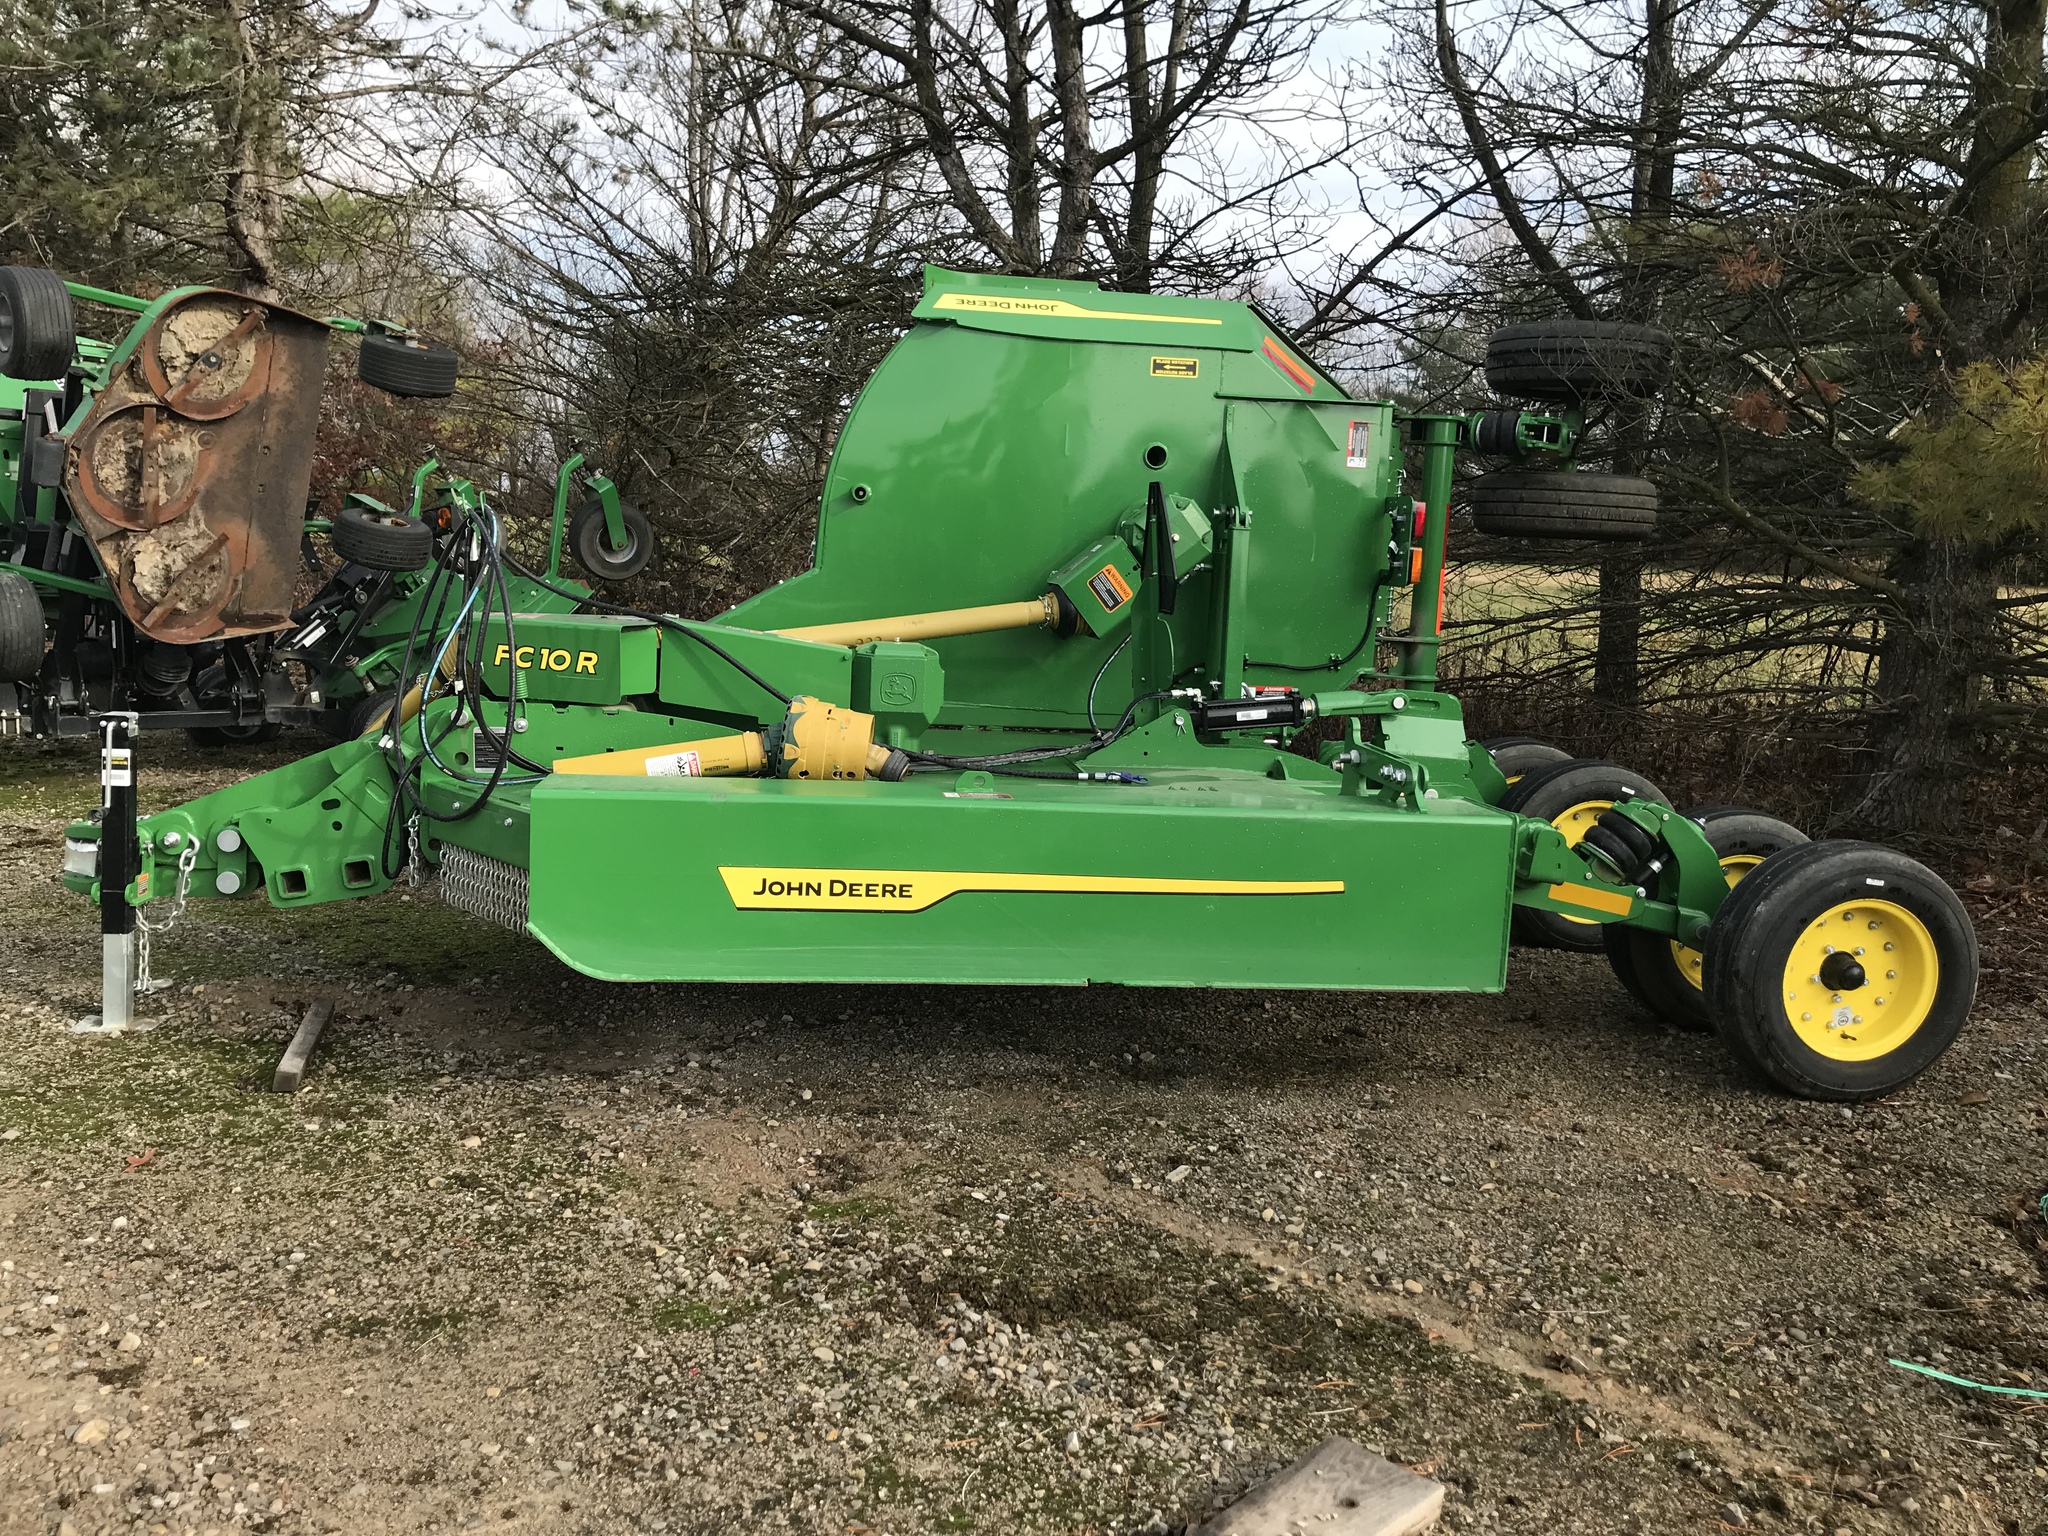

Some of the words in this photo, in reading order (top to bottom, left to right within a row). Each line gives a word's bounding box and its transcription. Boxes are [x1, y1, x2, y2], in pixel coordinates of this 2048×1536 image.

[955, 298, 1011, 309] DEERE
[1015, 303, 1059, 312] JOHN
[1110, 571, 1130, 598] WARNING
[753, 877, 822, 897] JOHN
[829, 878, 913, 898] DEERE
